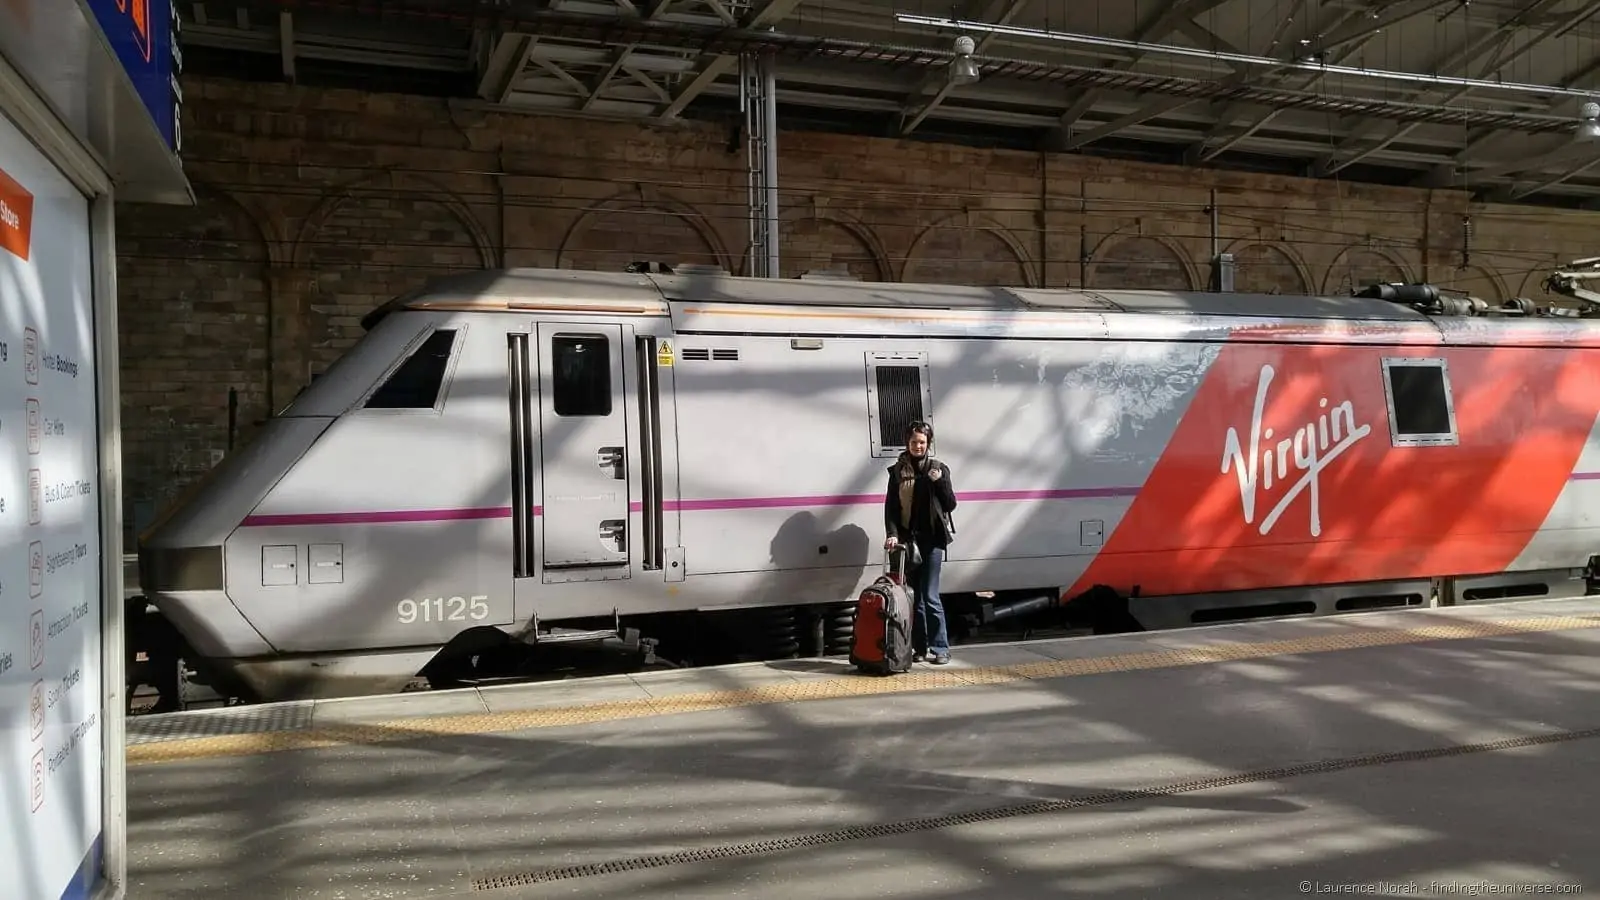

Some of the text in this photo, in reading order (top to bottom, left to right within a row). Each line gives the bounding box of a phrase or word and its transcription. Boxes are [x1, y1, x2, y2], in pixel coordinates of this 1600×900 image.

[0, 199, 20, 230] Store
[56, 355, 78, 378] Bookings
[1221, 364, 1371, 537] Virgin
[46, 543, 87, 573] Sightseeing Tours
[48, 601, 88, 638] Attraction Tickets
[397, 595, 489, 624] 91125
[62, 669, 80, 694] Tickets
